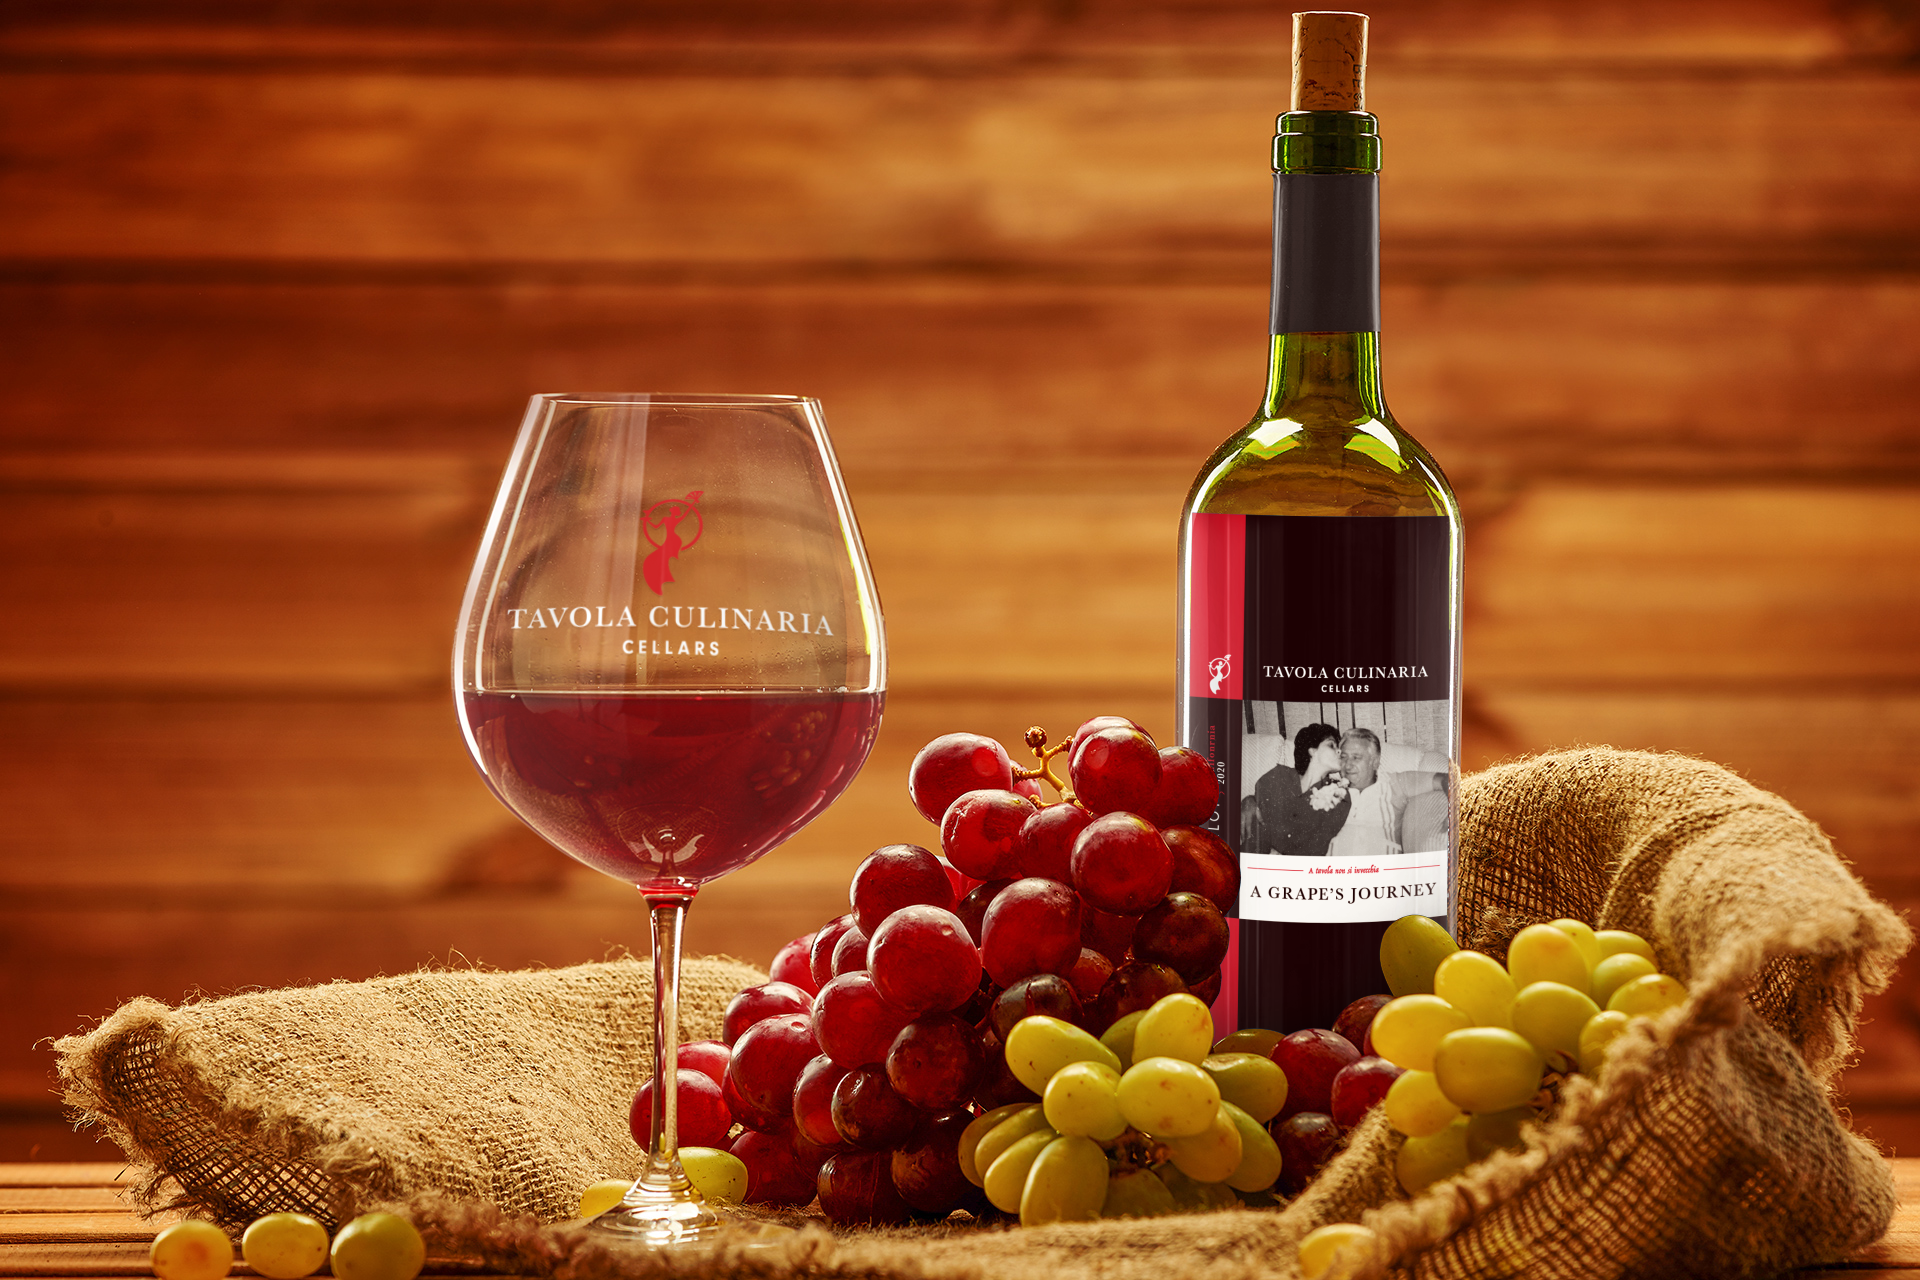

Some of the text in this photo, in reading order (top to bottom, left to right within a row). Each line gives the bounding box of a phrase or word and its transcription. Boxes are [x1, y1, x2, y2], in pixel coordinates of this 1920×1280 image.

[507, 605, 834, 636] TAVOLA CULINARIA
[622, 640, 719, 656] CELLARS
[1263, 665, 1428, 679] TAVOLA CULINARIA
[1321, 684, 1370, 693] CELLARS
[1216, 761, 1226, 785] 2020
[1315, 865, 1333, 874] tavola
[1250, 882, 1437, 904] A GRAPE’S JOURNEY
